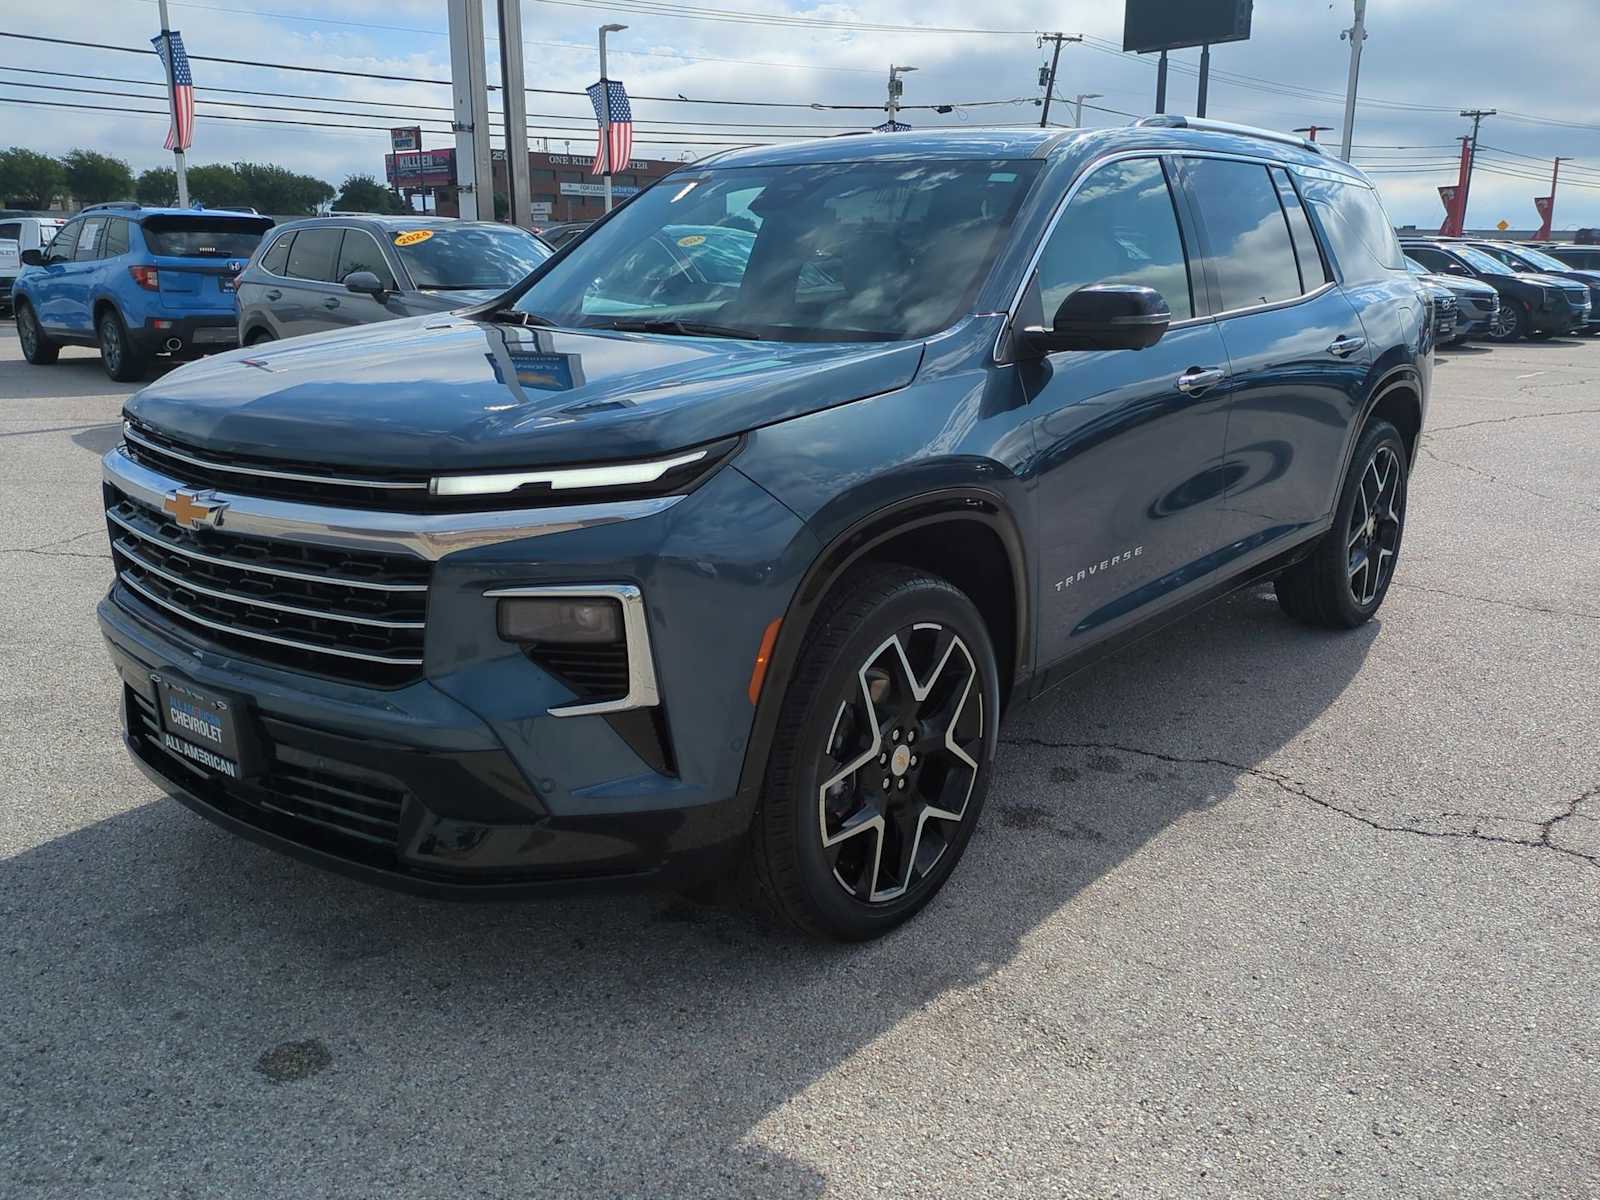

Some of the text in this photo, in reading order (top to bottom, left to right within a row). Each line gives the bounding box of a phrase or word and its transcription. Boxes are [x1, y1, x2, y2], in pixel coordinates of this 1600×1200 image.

[548, 155, 569, 165] ONE
[398, 231, 430, 244] 2024
[1055, 546, 1143, 592] TRAVERSE
[170, 707, 223, 743] CHEVROLET
[166, 734, 236, 778] ALL AMERICAN
